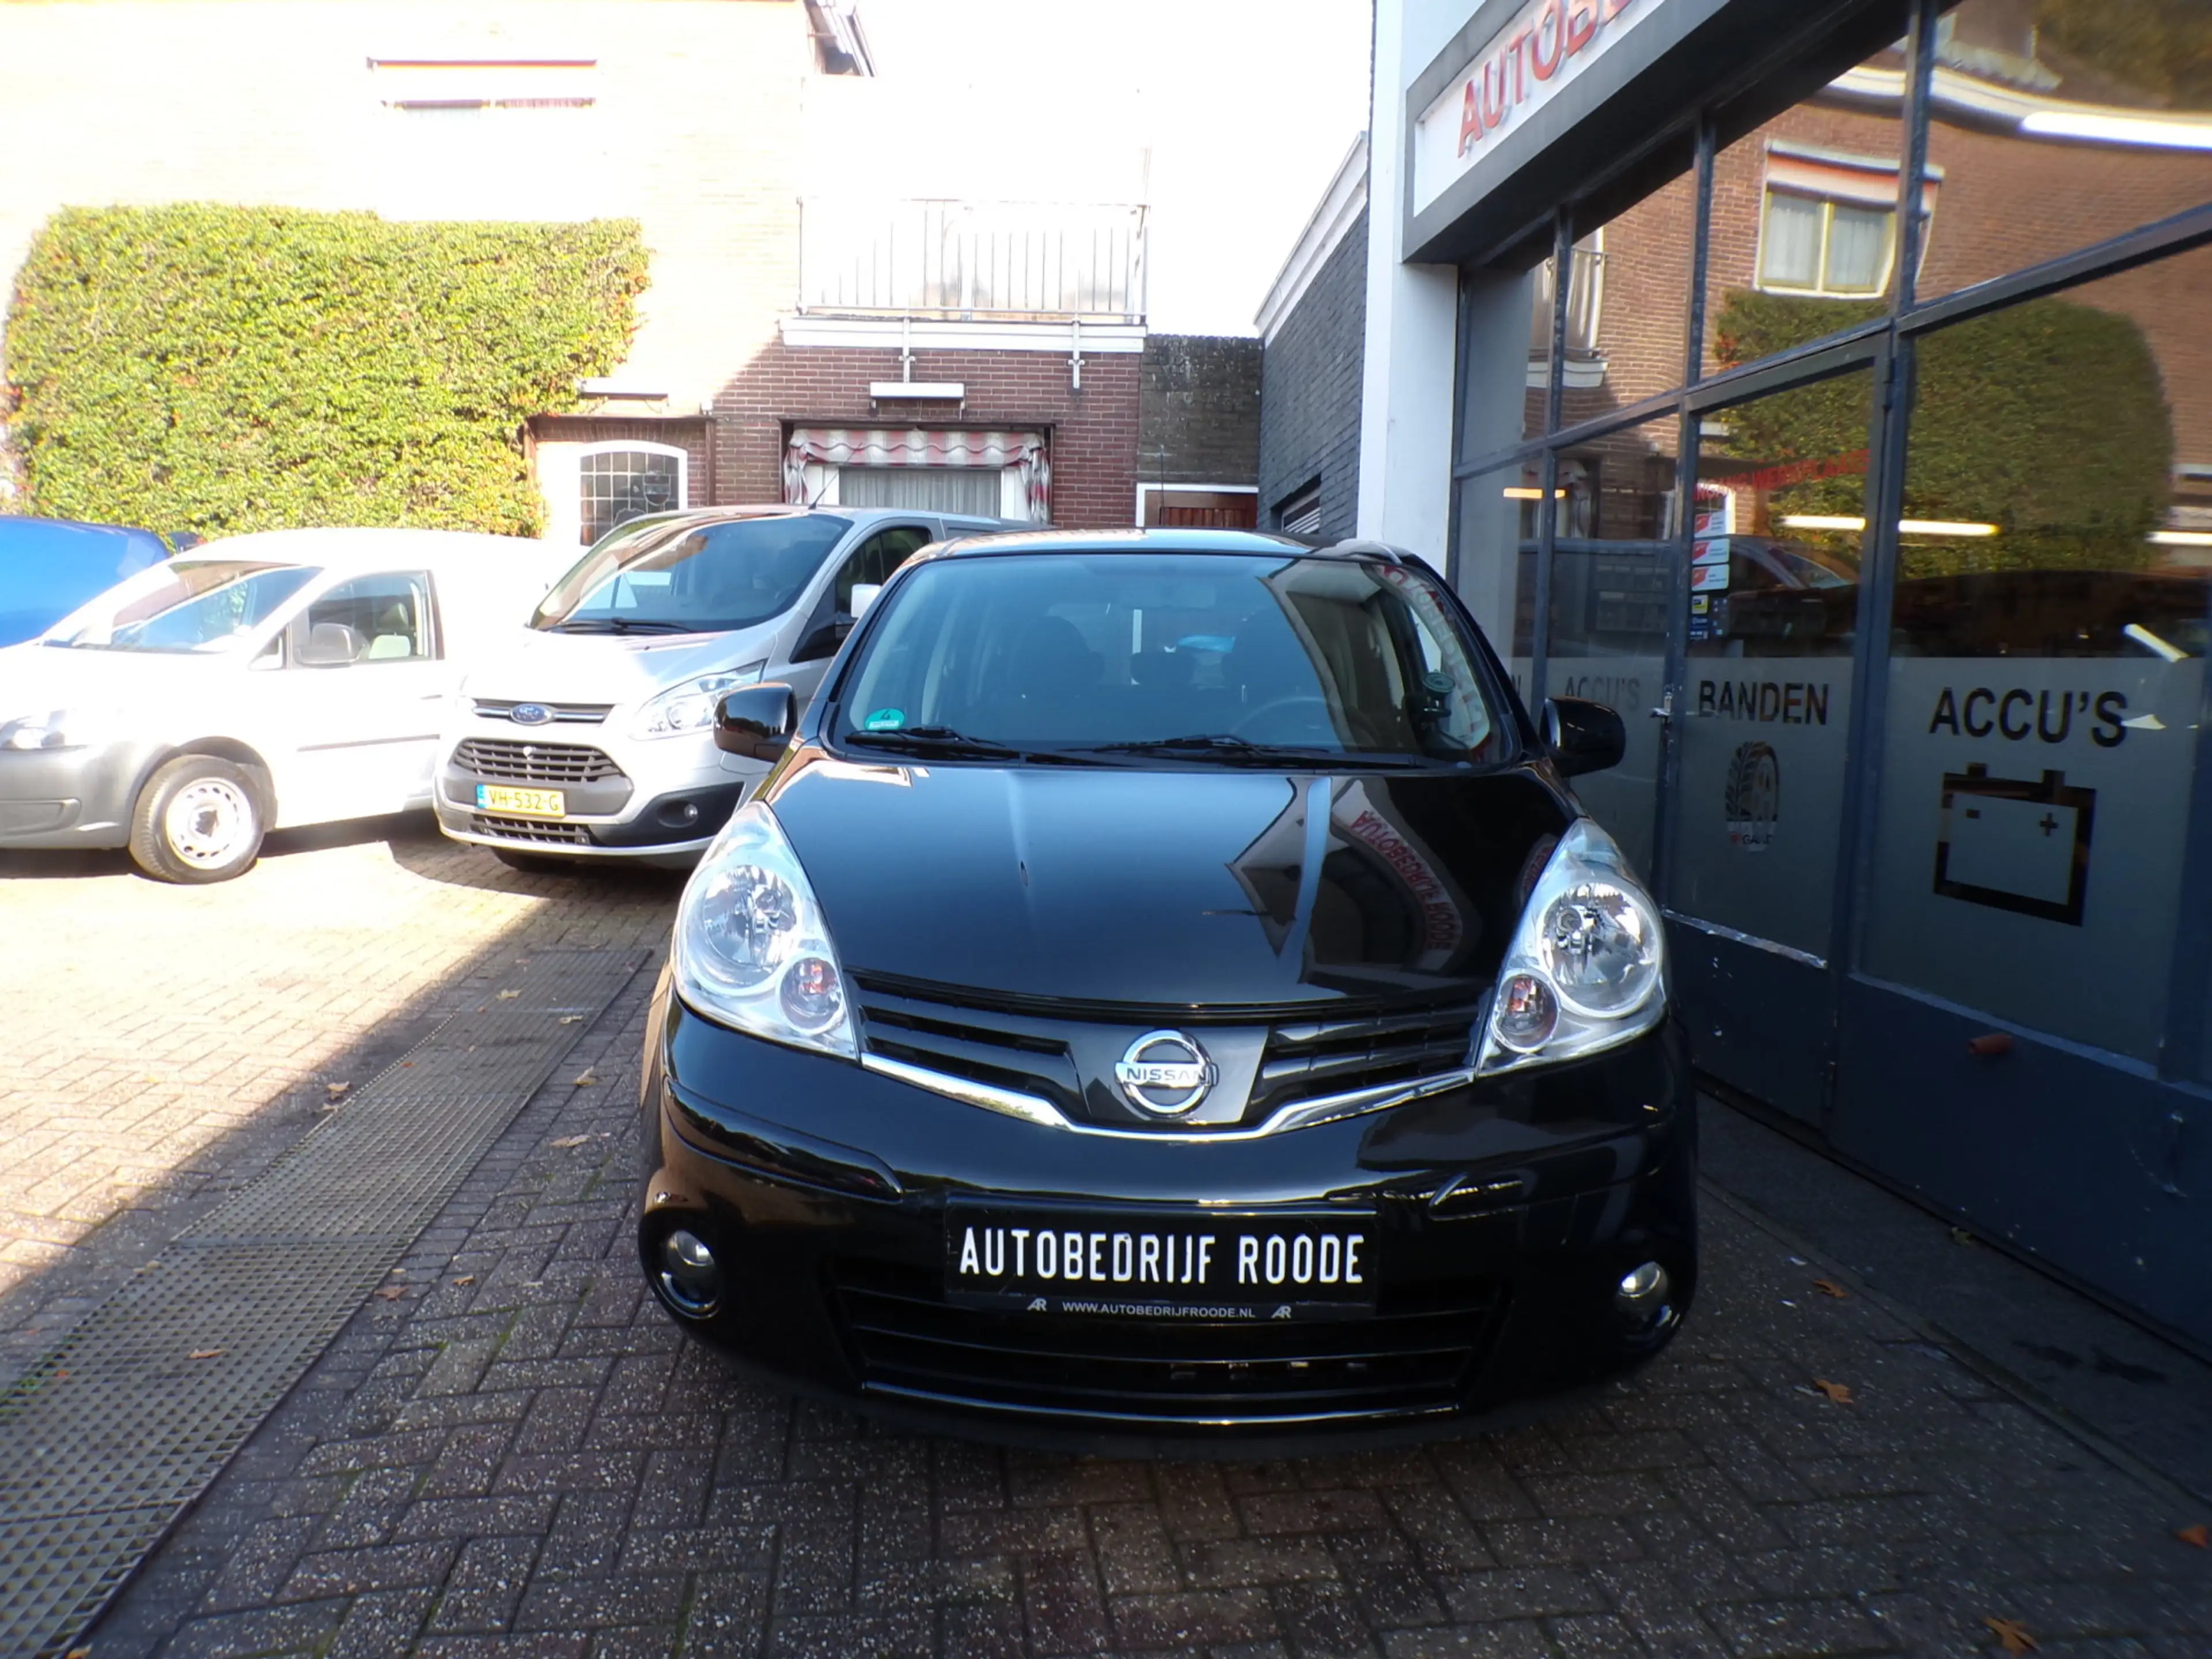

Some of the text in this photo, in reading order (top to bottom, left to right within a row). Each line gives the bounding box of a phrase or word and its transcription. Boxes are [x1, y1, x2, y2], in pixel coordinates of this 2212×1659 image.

[1699, 680, 1829, 725] BANDEN
[1929, 687, 2128, 748] ACCU'S
[488, 790, 559, 811] VH-532-G
[1127, 1067, 1206, 1082] NISSAN
[959, 1227, 1365, 1285] AUTOBEDRIJF ROODE
[1062, 1301, 1256, 1319] WWW.AUTOBEDRIJFROODE.NL
